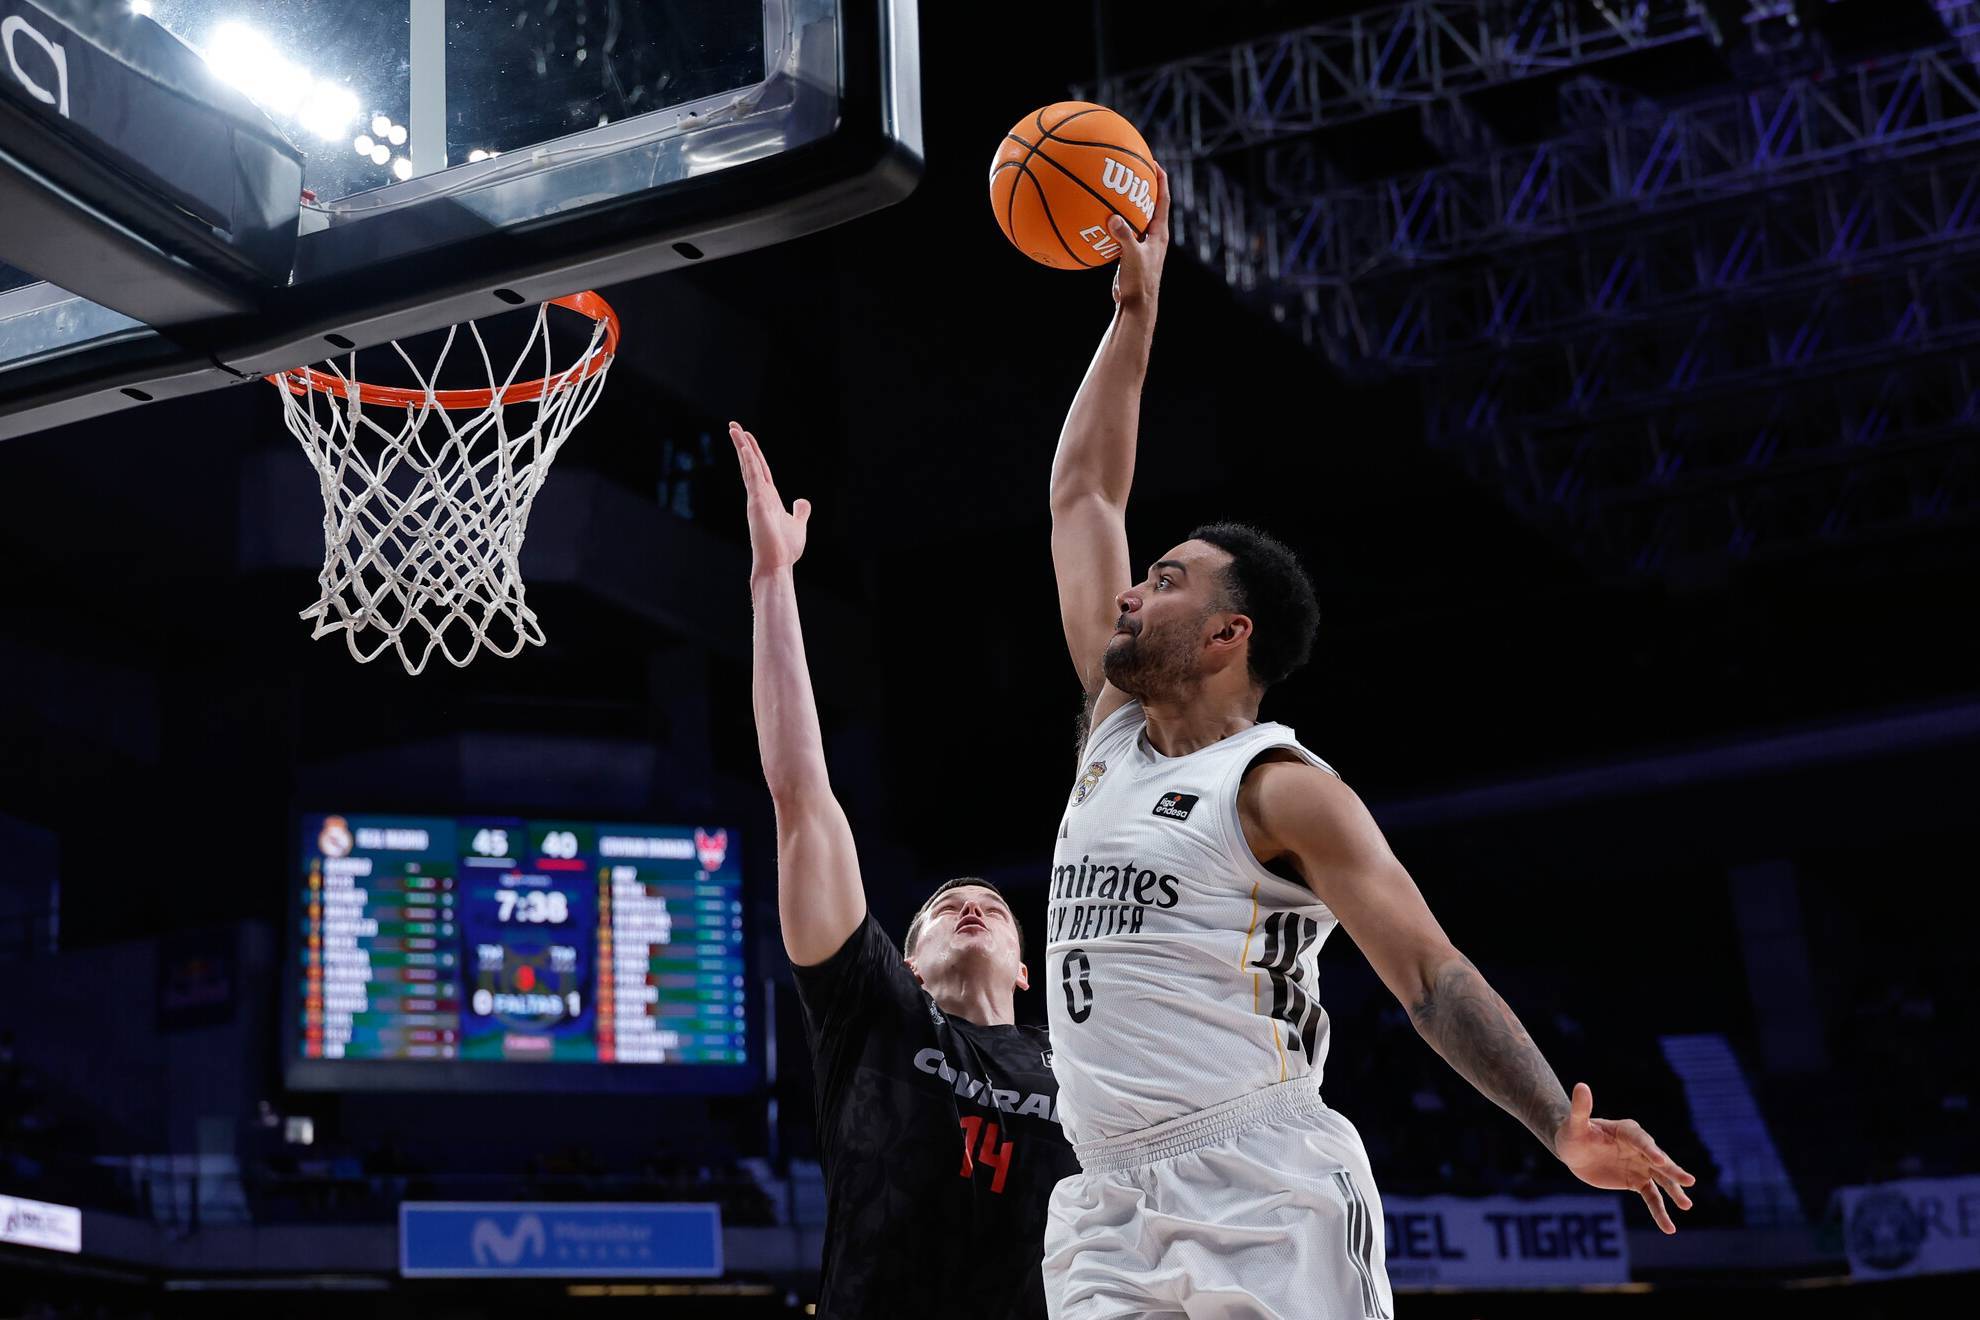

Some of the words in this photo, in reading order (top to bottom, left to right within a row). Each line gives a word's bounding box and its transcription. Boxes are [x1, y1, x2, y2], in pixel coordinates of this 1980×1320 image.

[1155, 805, 1188, 818] endesa
[472, 828, 508, 857] 45
[1050, 855, 1179, 908] mirates
[1048, 907, 1067, 942] LY
[1068, 905, 1144, 940] BETTER
[1062, 949, 1093, 1023] 0
[960, 1115, 1014, 1194] 14
[1483, 1212, 1621, 1261] TIGRE
